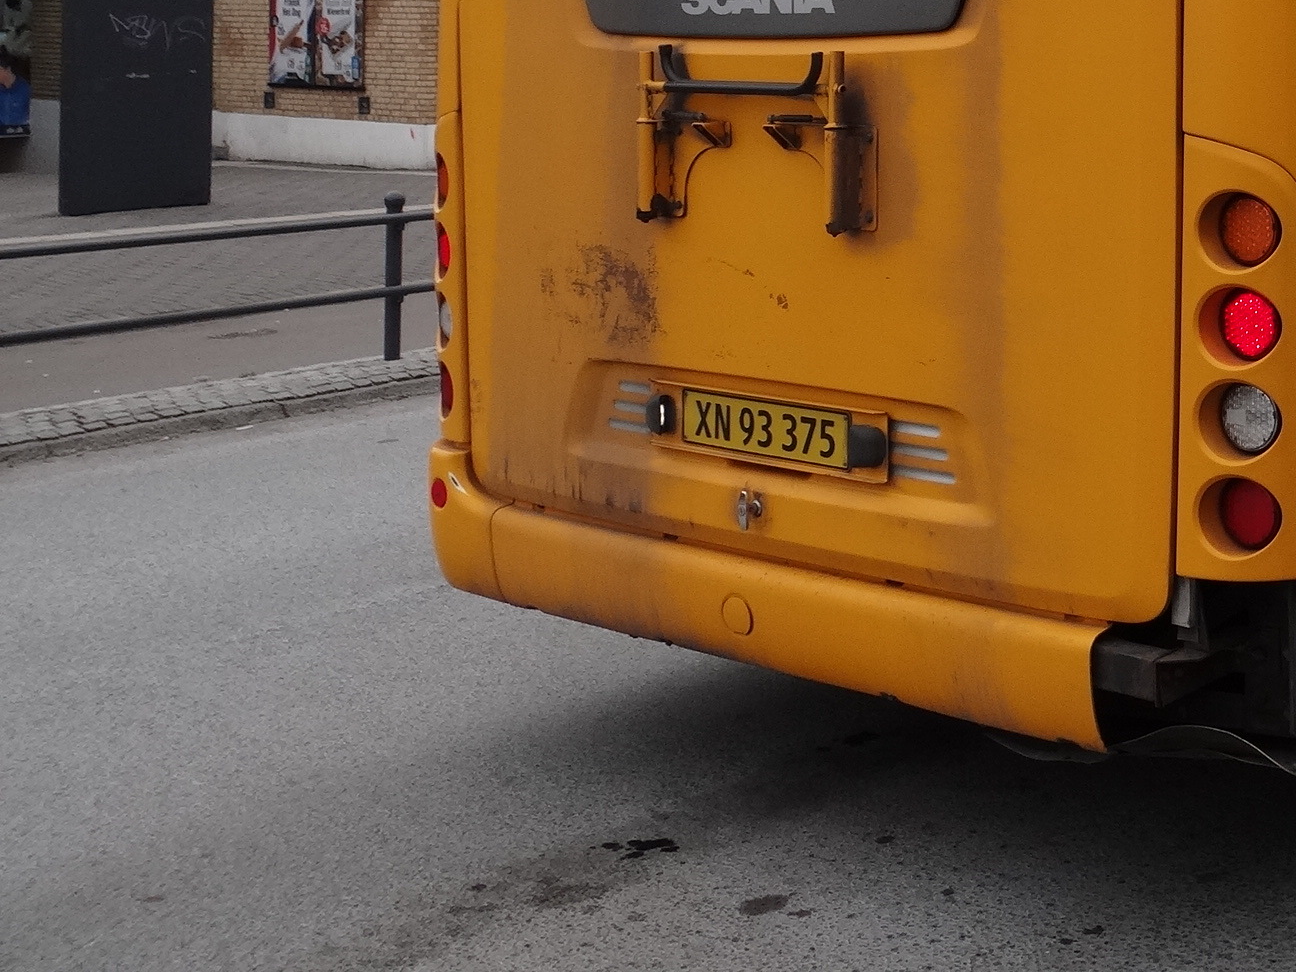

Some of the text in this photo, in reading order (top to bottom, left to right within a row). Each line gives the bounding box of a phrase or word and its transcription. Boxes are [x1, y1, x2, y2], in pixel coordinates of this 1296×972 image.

[695, 400, 836, 459] XN 93 375
